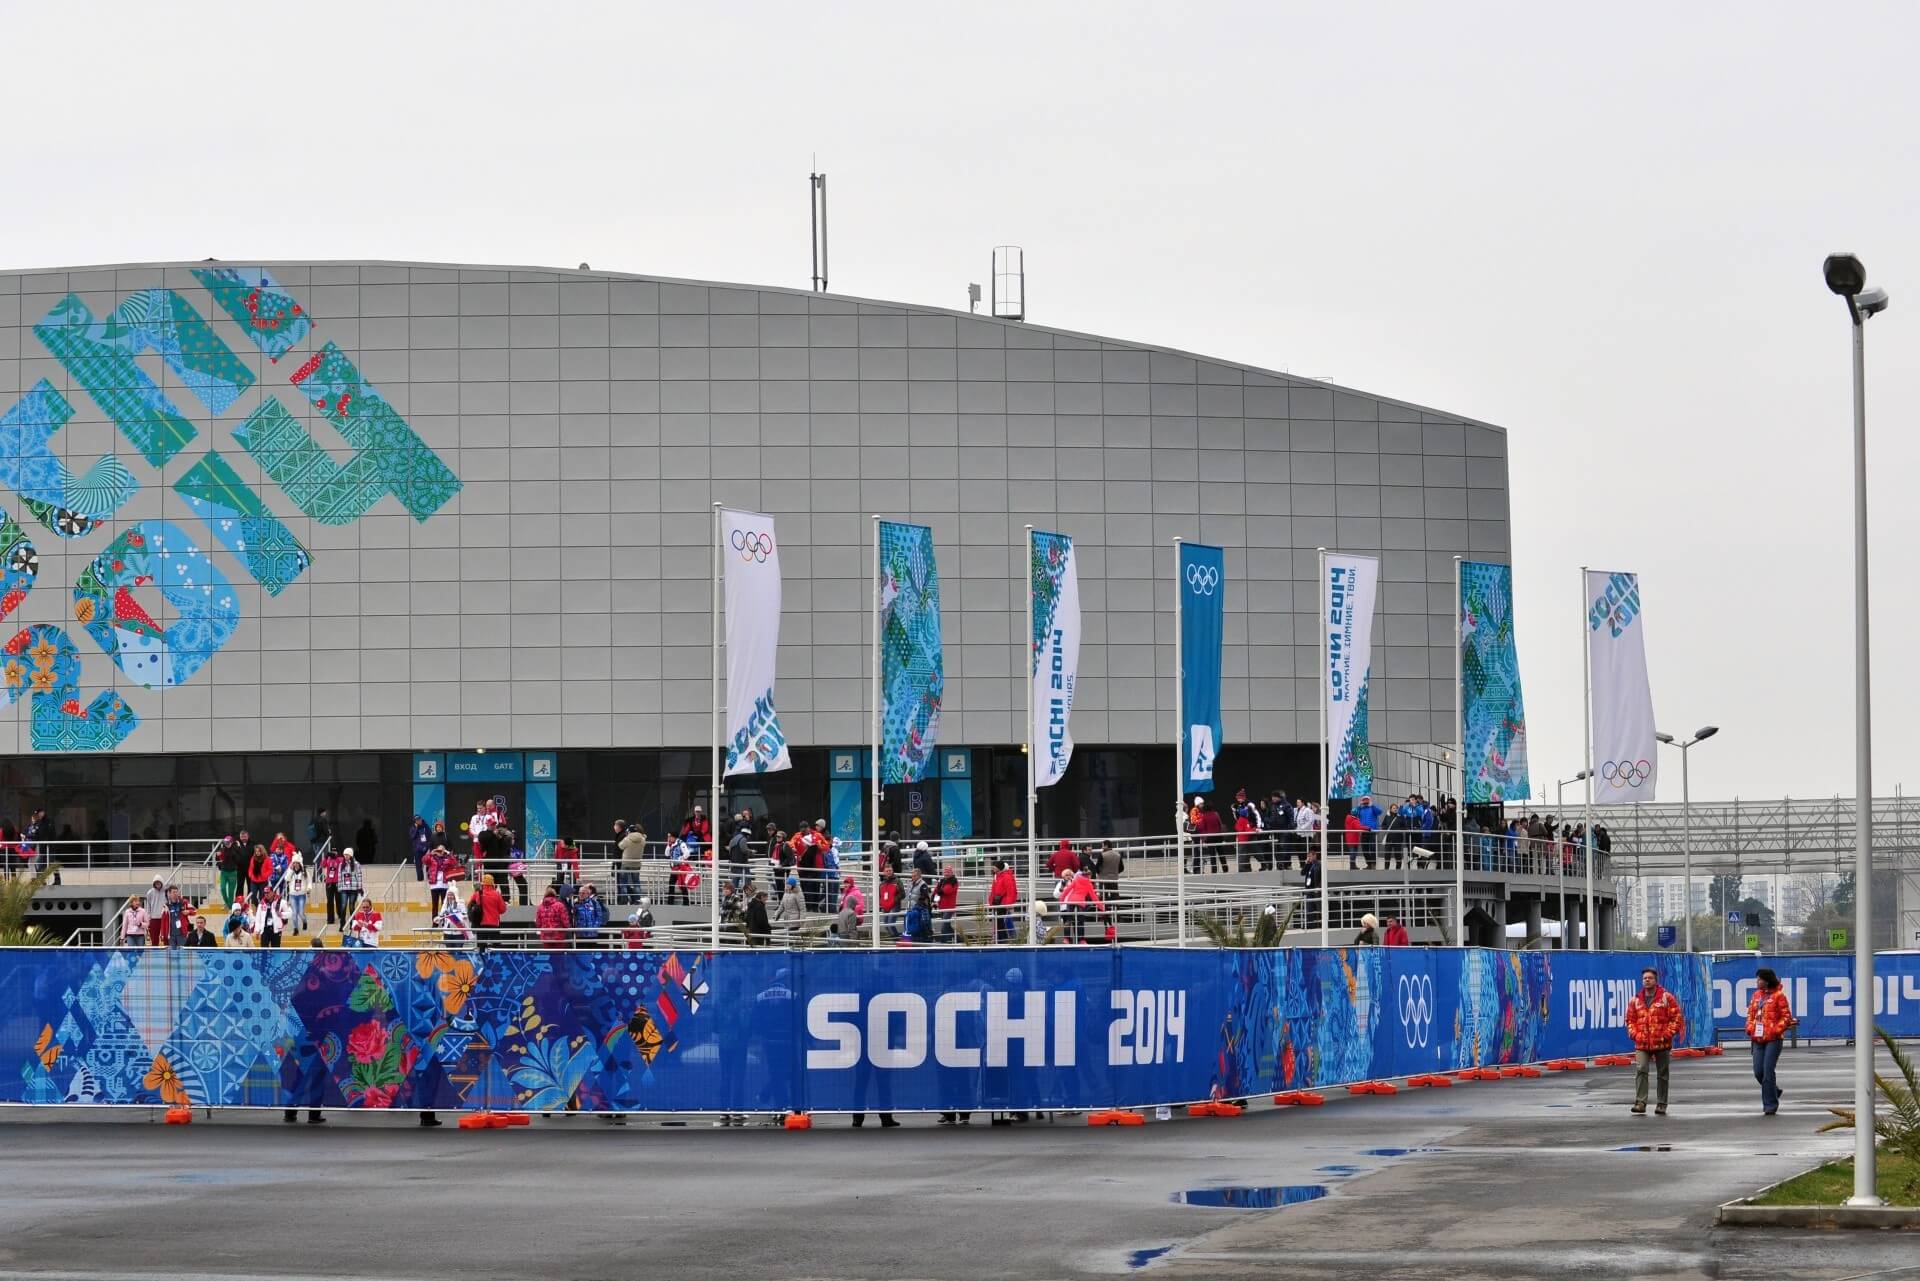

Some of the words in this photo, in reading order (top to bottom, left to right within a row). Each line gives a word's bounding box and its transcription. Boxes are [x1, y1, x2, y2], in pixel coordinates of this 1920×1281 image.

[1330, 567, 1346, 624] 2014
[1050, 629, 1063, 690] 2014
[1330, 633, 1342, 701] СОЧИ
[806, 990, 1076, 1069] SOCHI
[1108, 989, 1186, 1066] 2014
[1569, 979, 1605, 1030] СОЧИ
